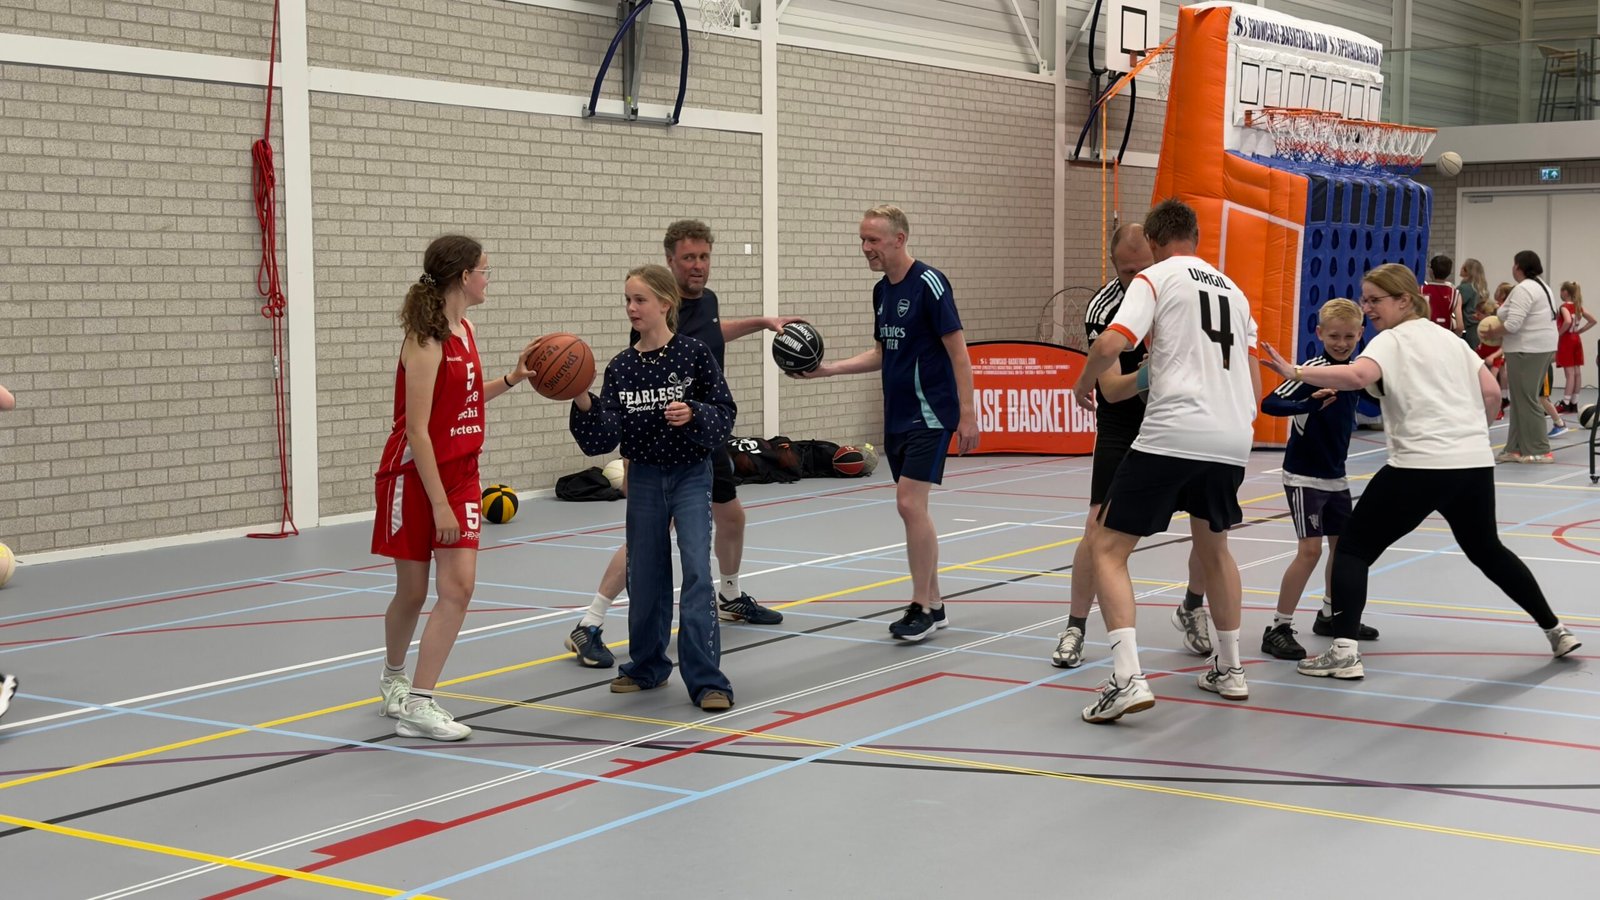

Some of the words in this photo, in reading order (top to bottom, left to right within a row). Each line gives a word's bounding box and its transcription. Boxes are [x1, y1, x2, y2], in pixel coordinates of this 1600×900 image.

[1188, 268, 1231, 290] VIRGIL
[1198, 290, 1234, 371] 4
[466, 361, 475, 391] 5
[618, 385, 684, 405] FEARLESS
[464, 502, 480, 530] 5
